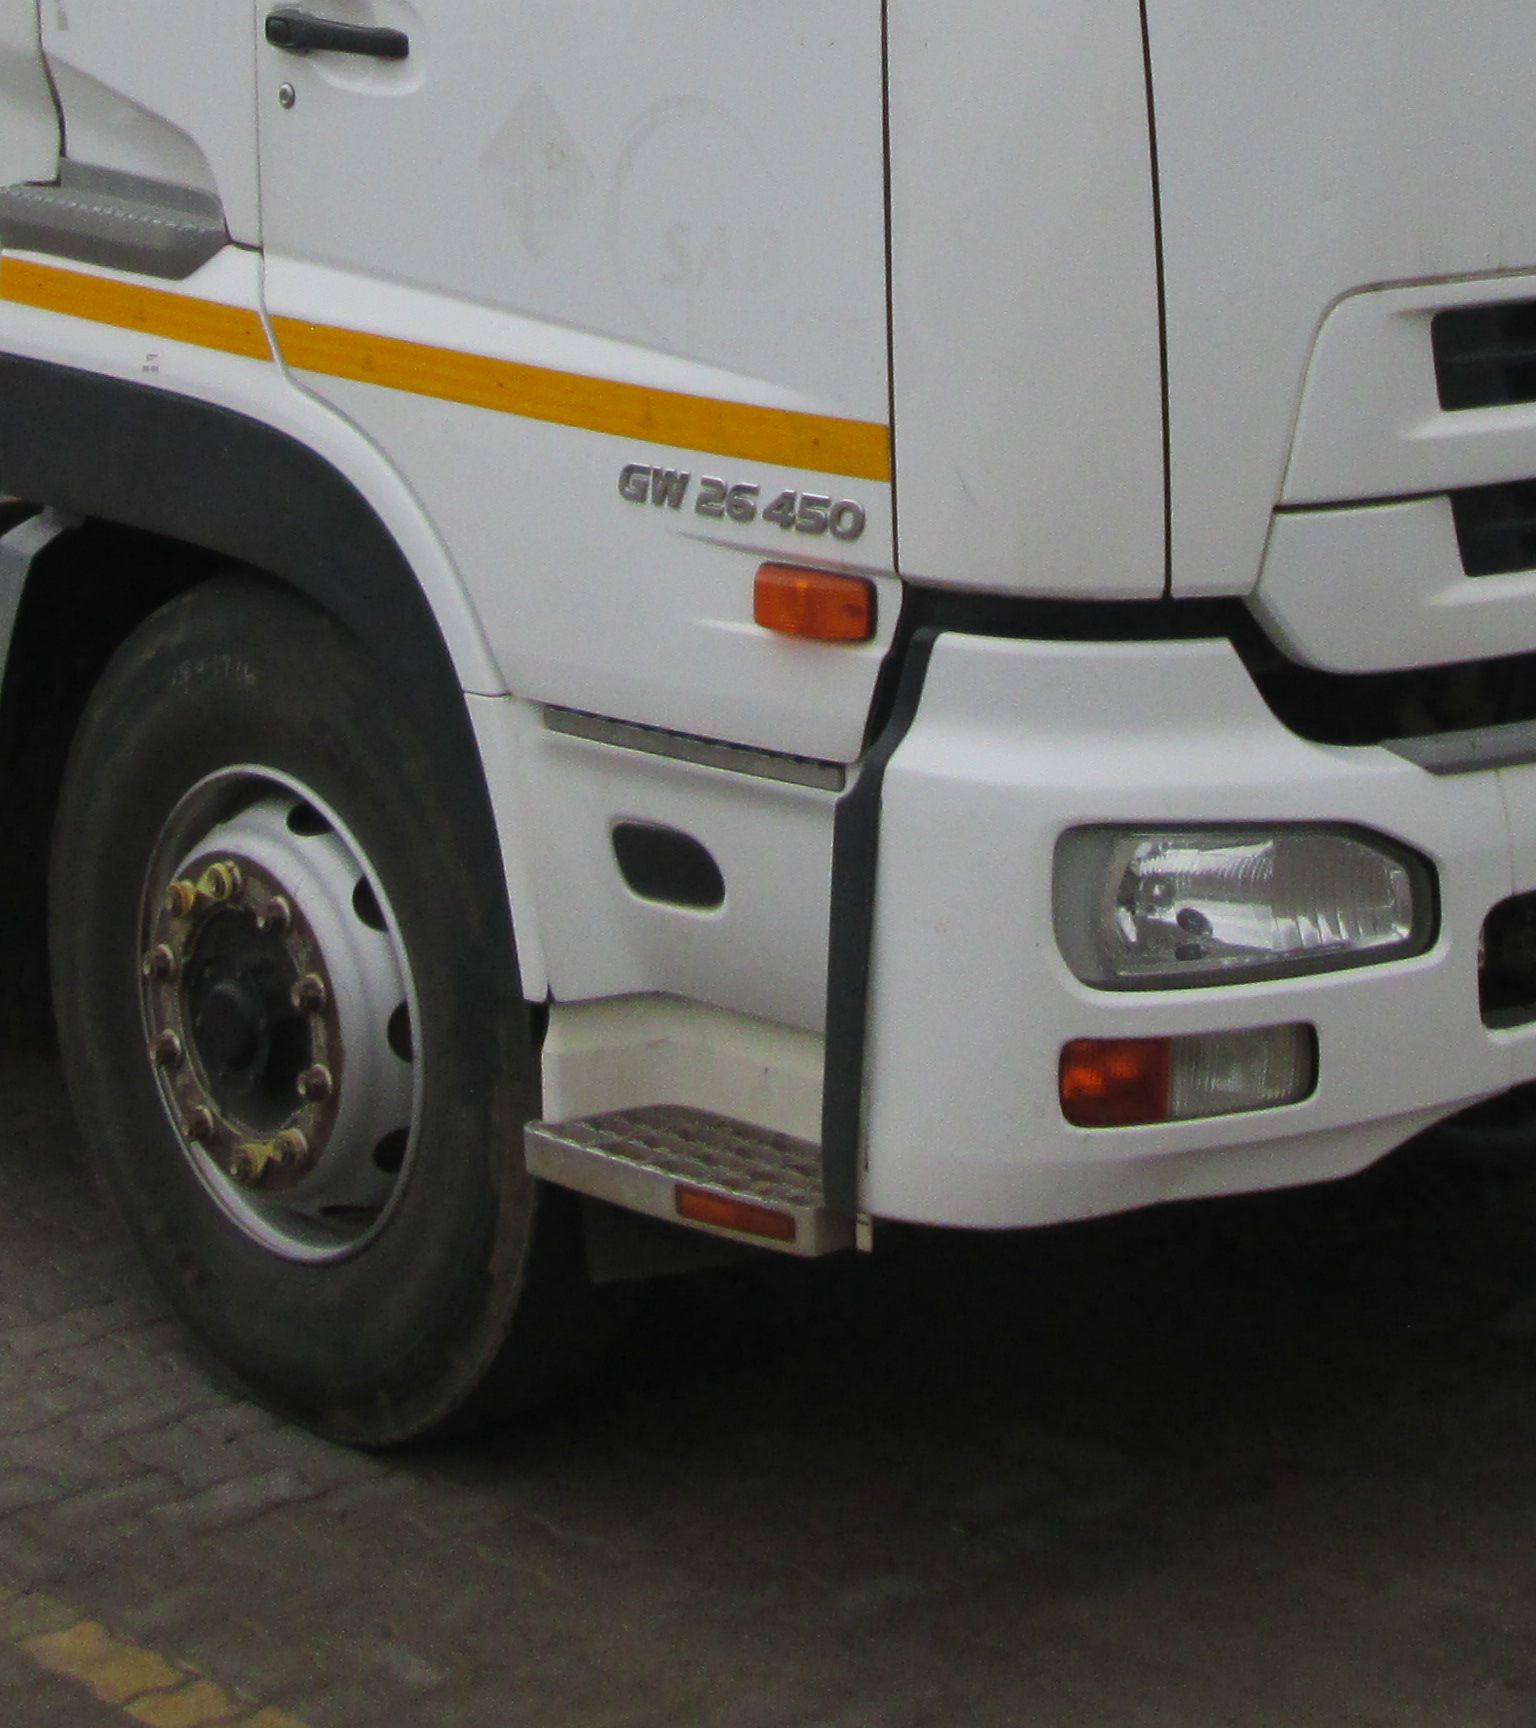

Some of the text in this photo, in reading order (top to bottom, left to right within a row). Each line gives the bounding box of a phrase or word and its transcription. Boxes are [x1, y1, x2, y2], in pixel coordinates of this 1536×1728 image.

[618, 462, 866, 542] GW 26 450
